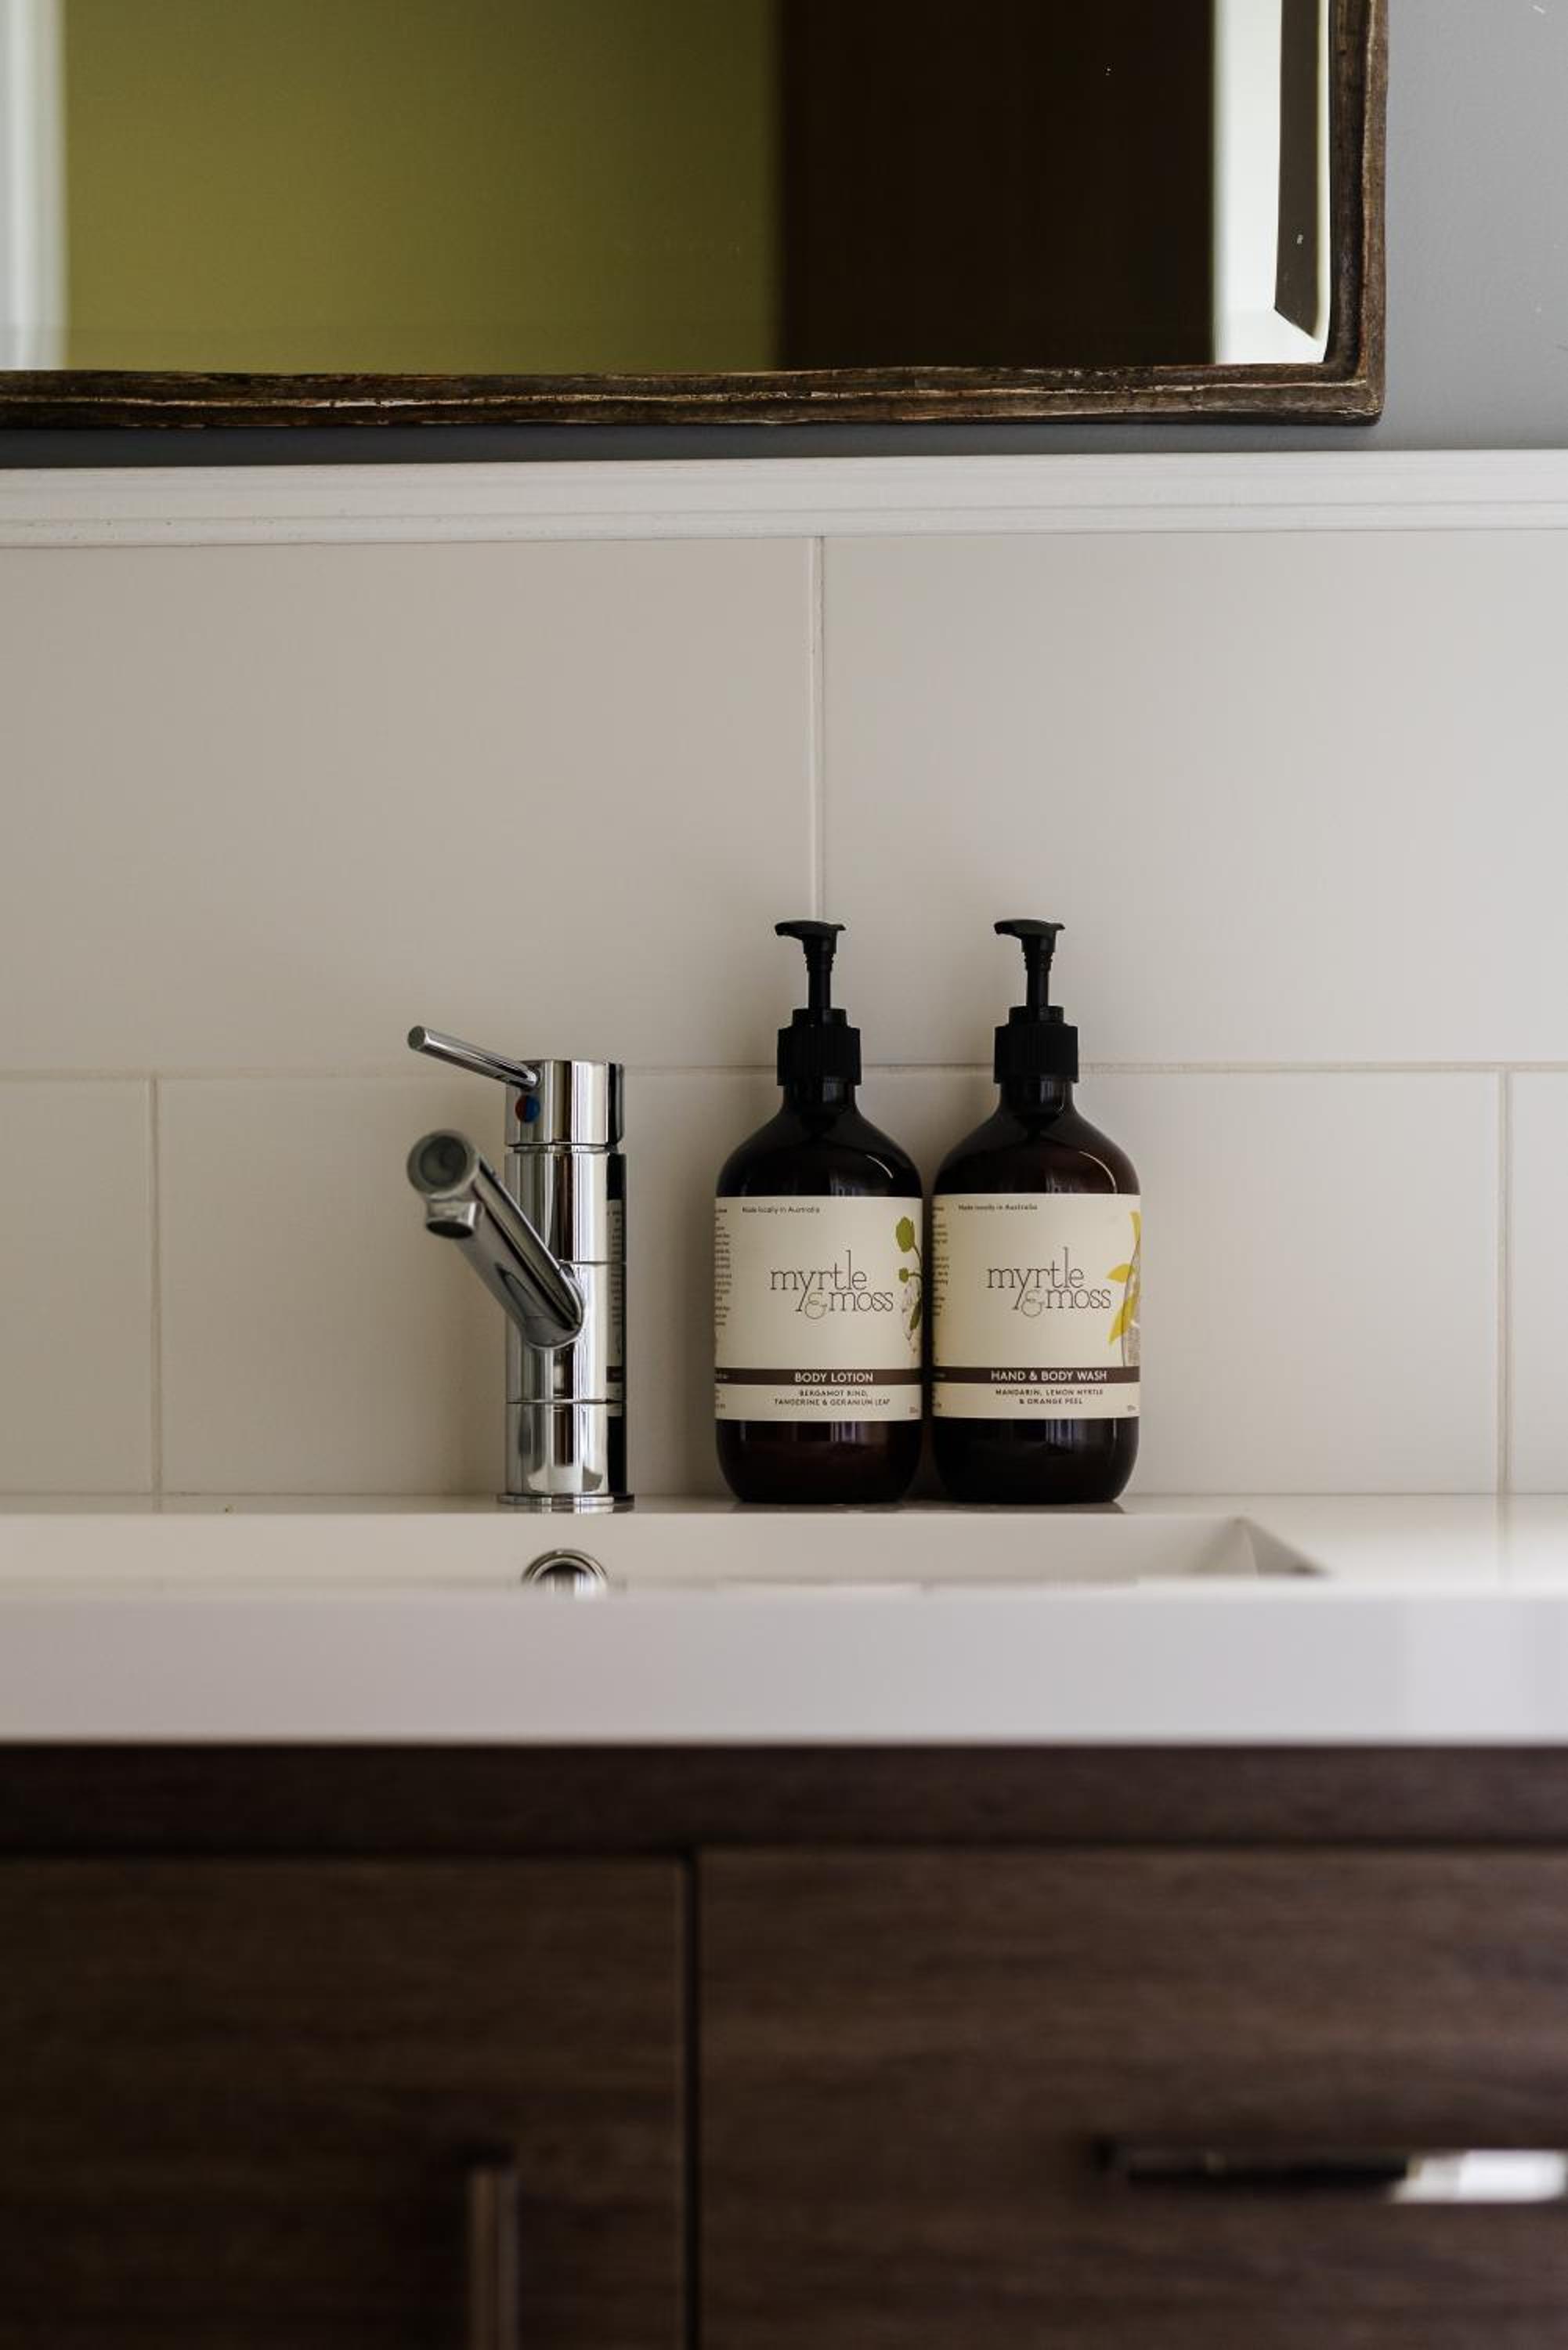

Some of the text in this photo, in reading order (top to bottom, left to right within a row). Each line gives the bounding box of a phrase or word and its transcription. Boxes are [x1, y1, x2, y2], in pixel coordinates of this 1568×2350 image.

[771, 1249, 867, 1312] myrtle
[988, 1247, 1084, 1310] myrtle
[795, 1372, 873, 1383] BODY LOTION
[991, 1371, 1107, 1381] HAND & BODY WASH
